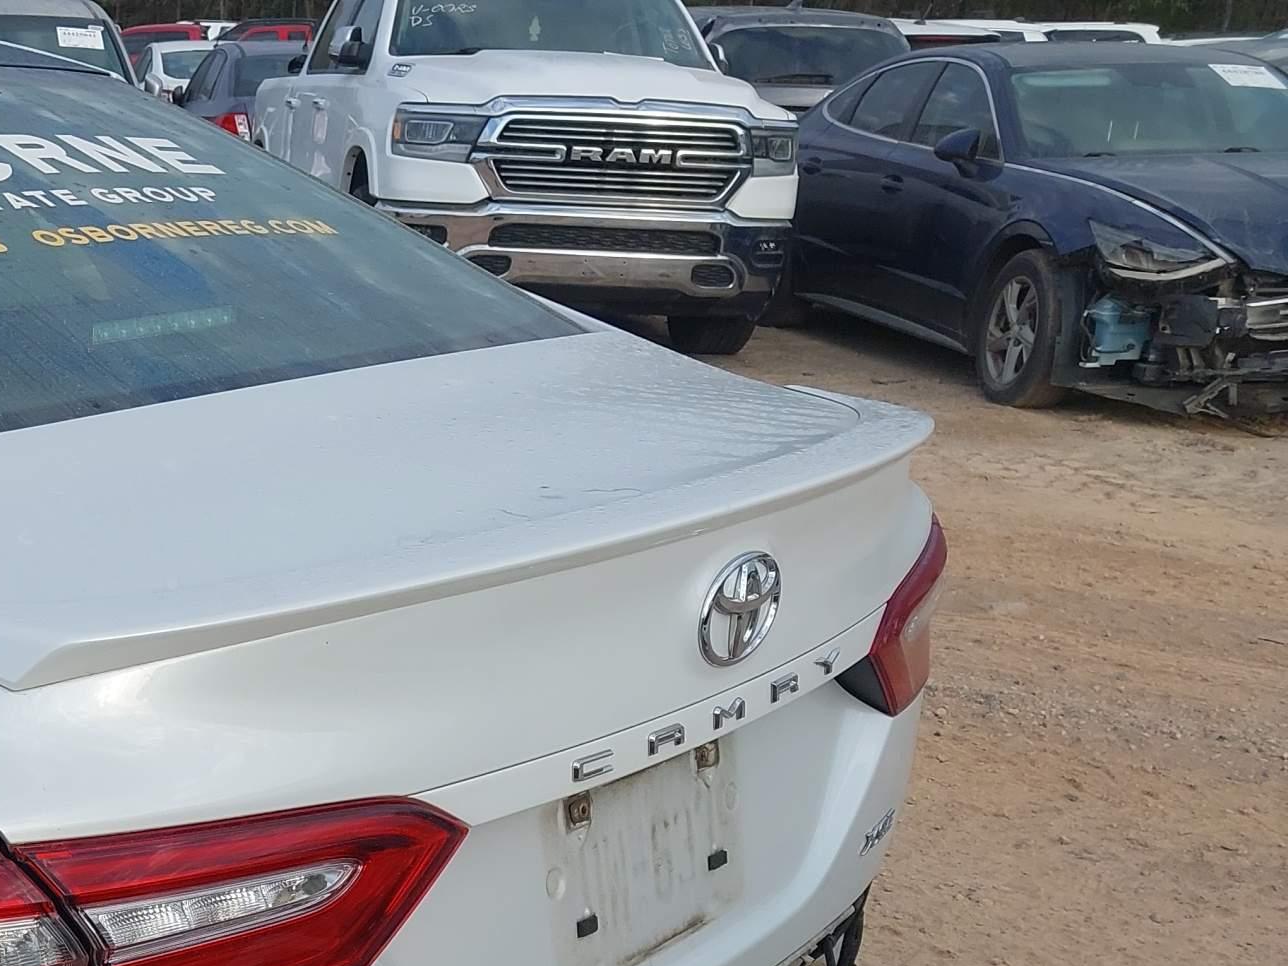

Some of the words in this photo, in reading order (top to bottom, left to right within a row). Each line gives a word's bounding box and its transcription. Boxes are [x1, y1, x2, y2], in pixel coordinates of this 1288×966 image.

[571, 146, 672, 164] RAM
[90, 186, 218, 206] GROUP
[32, 219, 339, 248] OSBORNEREG.COM
[572, 646, 841, 783] CAMRY
